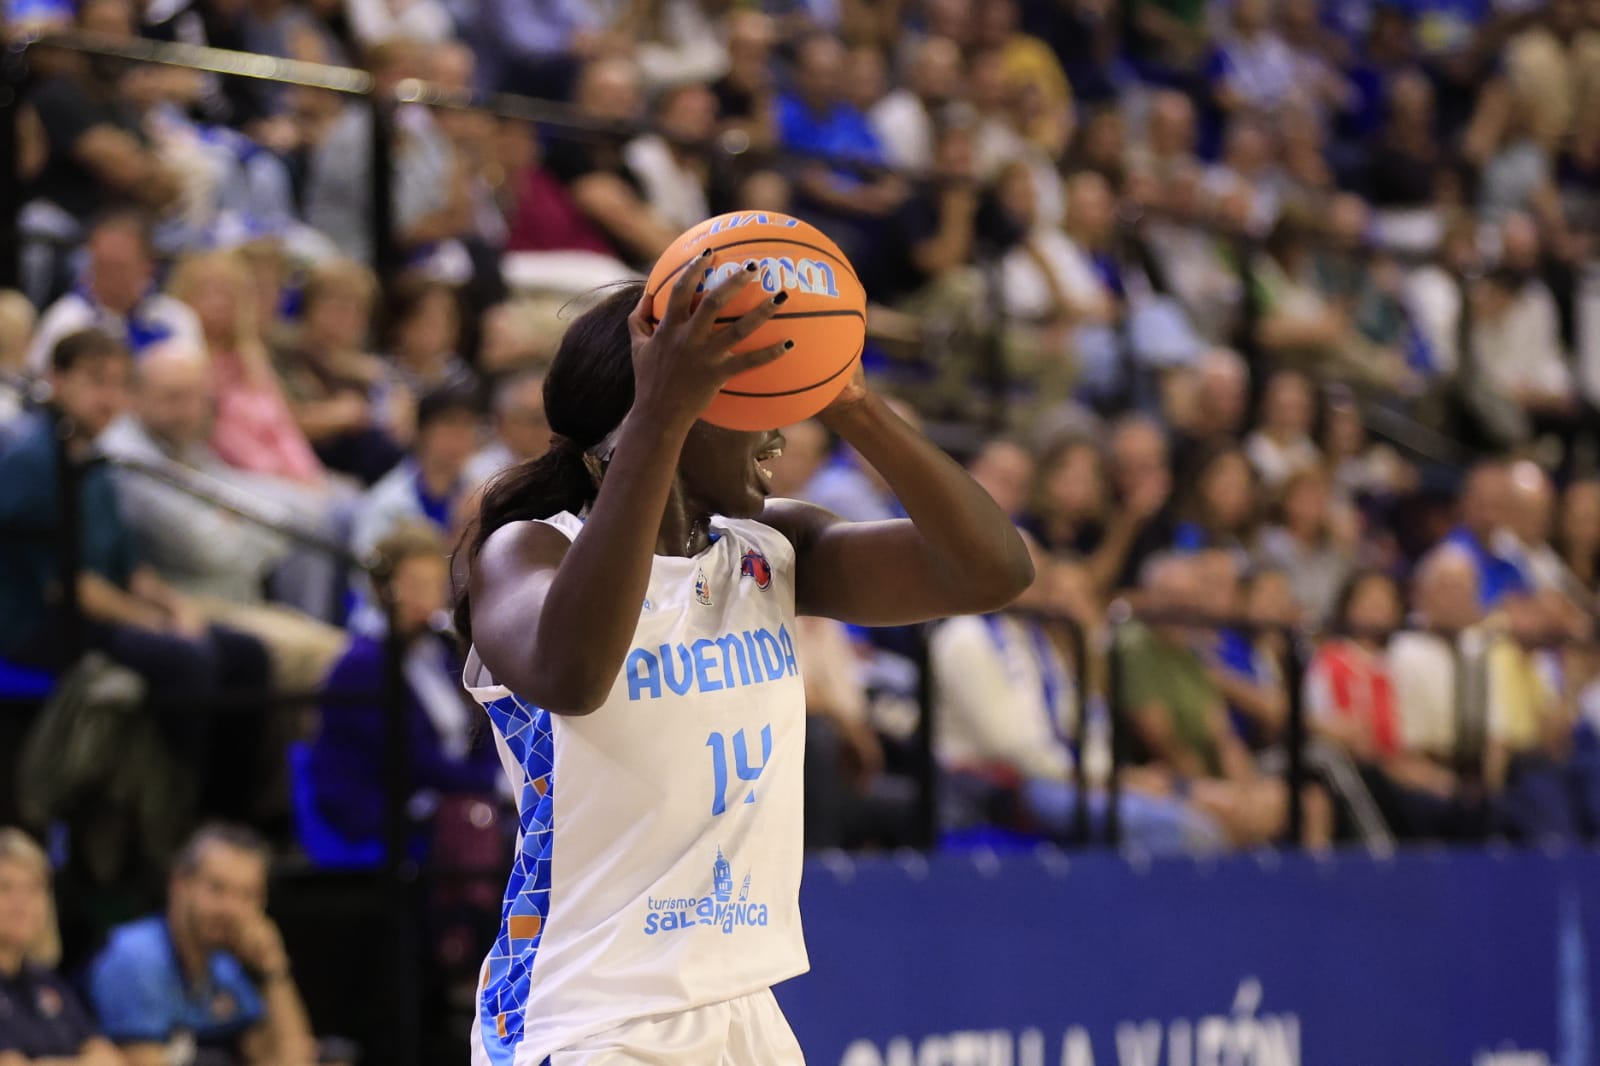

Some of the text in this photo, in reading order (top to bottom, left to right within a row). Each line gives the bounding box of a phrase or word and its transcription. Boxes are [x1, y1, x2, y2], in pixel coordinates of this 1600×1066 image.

[626, 623, 798, 701] AVENIDA
[705, 723, 772, 816] 14
[648, 896, 697, 910] turismo
